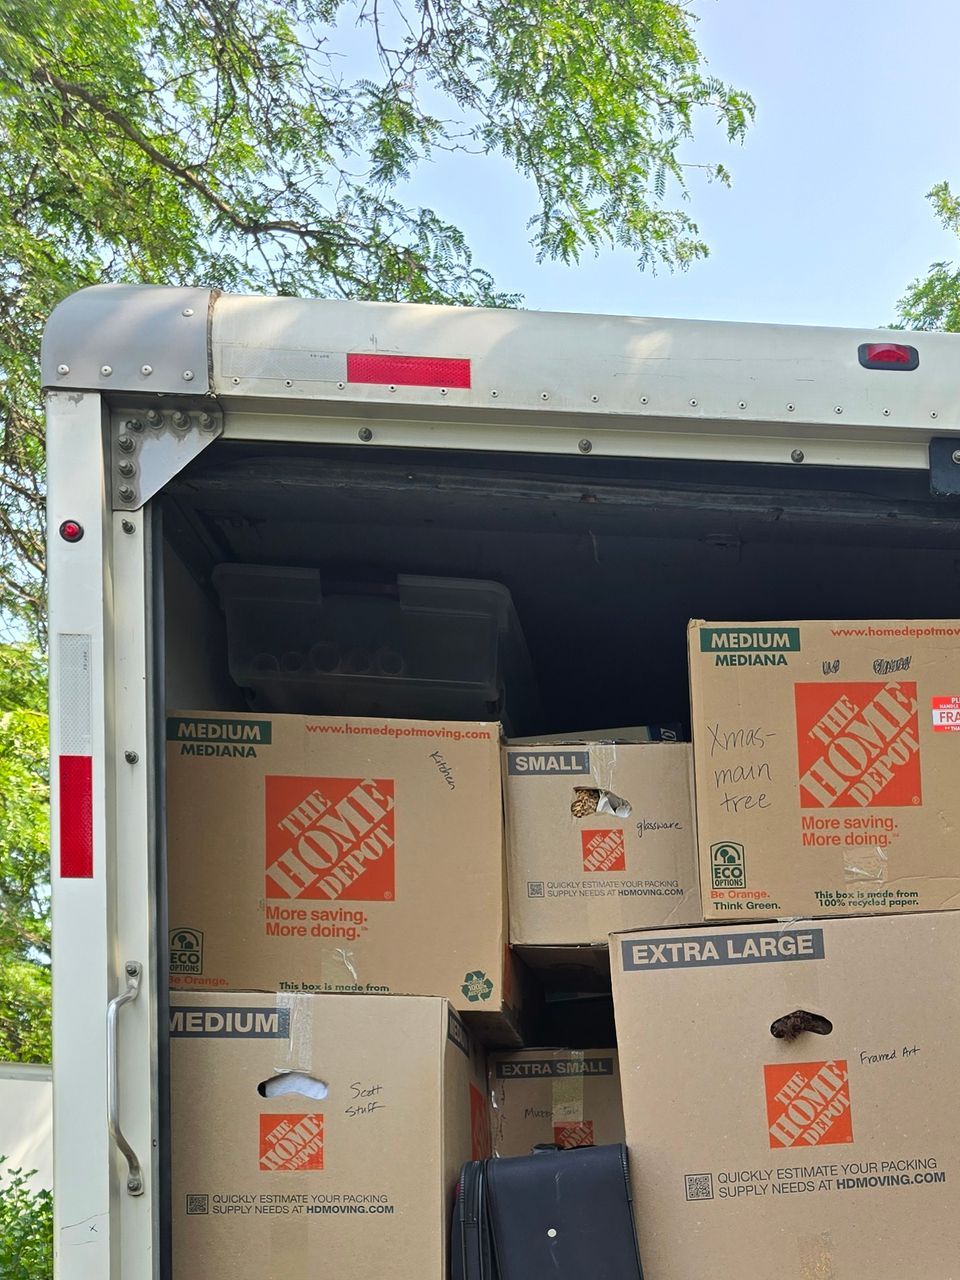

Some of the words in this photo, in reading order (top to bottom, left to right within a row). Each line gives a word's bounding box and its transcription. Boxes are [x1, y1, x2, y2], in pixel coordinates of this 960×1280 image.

[711, 631, 790, 649] MEDIUM
[714, 654, 788, 667] MEDIANA
[808, 693, 860, 746] THE
[177, 722, 262, 741] MEDIUM
[306, 723, 491, 741] www.homedepotmoving.com
[180, 744, 257, 758] MEDIANA
[799, 681, 919, 808] HOME
[428, 750, 455, 790] Kitchen
[515, 755, 583, 771] SMALL
[847, 727, 920, 808] DEPOT
[714, 762, 773, 789] main
[719, 792, 772, 813] tree
[277, 789, 332, 838] THE
[636, 819, 683, 838] glassware
[801, 815, 839, 831] More
[843, 816, 899, 834] saving.
[265, 777, 395, 900] HOME
[586, 832, 604, 851] THE
[802, 832, 840, 847] More
[844, 831, 892, 849] doing.
[583, 829, 624, 872] HOME
[600, 845, 625, 872] DEPOT
[316, 823, 395, 900] DEPOT
[714, 866, 743, 879] ECO
[714, 878, 743, 888] OPTIONS
[710, 890, 727, 899] Be
[729, 889, 770, 900] Orange.
[814, 891, 834, 900] This
[836, 891, 854, 899] box
[856, 890, 865, 899] is
[867, 890, 894, 899] made
[896, 889, 919, 899] from
[819, 899, 846, 907] 100%
[848, 898, 886, 908] recycled
[713, 901, 744, 910] Think
[746, 900, 781, 910] Green.
[265, 906, 307, 921] More
[310, 907, 368, 925] saving.
[265, 922, 307, 937] More
[310, 923, 361, 941] doing.
[170, 952, 200, 965] ECO
[632, 938, 720, 966] EXTRA
[727, 934, 815, 960] LARGE
[169, 964, 200, 972] OPTIONS
[184, 975, 229, 987] Orange.
[279, 981, 299, 990] This
[302, 982, 321, 991] box
[324, 982, 332, 991] is
[335, 983, 362, 992] made
[366, 983, 390, 992] from
[169, 1011, 279, 1033] MEDIUM
[859, 1050, 897, 1064] Framed
[901, 1046, 921, 1058] Art
[502, 1063, 552, 1076] EXTRA
[556, 1061, 608, 1074] SMALL
[774, 1070, 809, 1107] THE
[768, 1060, 849, 1148] HOME
[801, 1091, 852, 1147] DEPOT
[265, 1119, 293, 1144] THE
[259, 1113, 324, 1171] HOME
[284, 1135, 324, 1171] DEPOT
[717, 1170, 774, 1184] QUICKLY
[776, 1164, 838, 1180] ESTIMATE
[840, 1162, 878, 1175] YOUR
[881, 1157, 938, 1173] PACKING
[718, 1183, 770, 1199] SUPPLY
[771, 1180, 816, 1195] NEEDS
[817, 1179, 834, 1191] AT
[836, 1171, 946, 1190] HDMOVING.COM
[212, 1194, 258, 1204] QUICKLY
[259, 1194, 309, 1204] ESTIMATE
[311, 1194, 341, 1204] YOUR
[343, 1194, 388, 1203] PACKING
[212, 1205, 253, 1214] SUPPLY
[255, 1205, 290, 1214] NEEDS
[291, 1205, 304, 1214] AT
[306, 1205, 394, 1214] HDMOVING.COM
